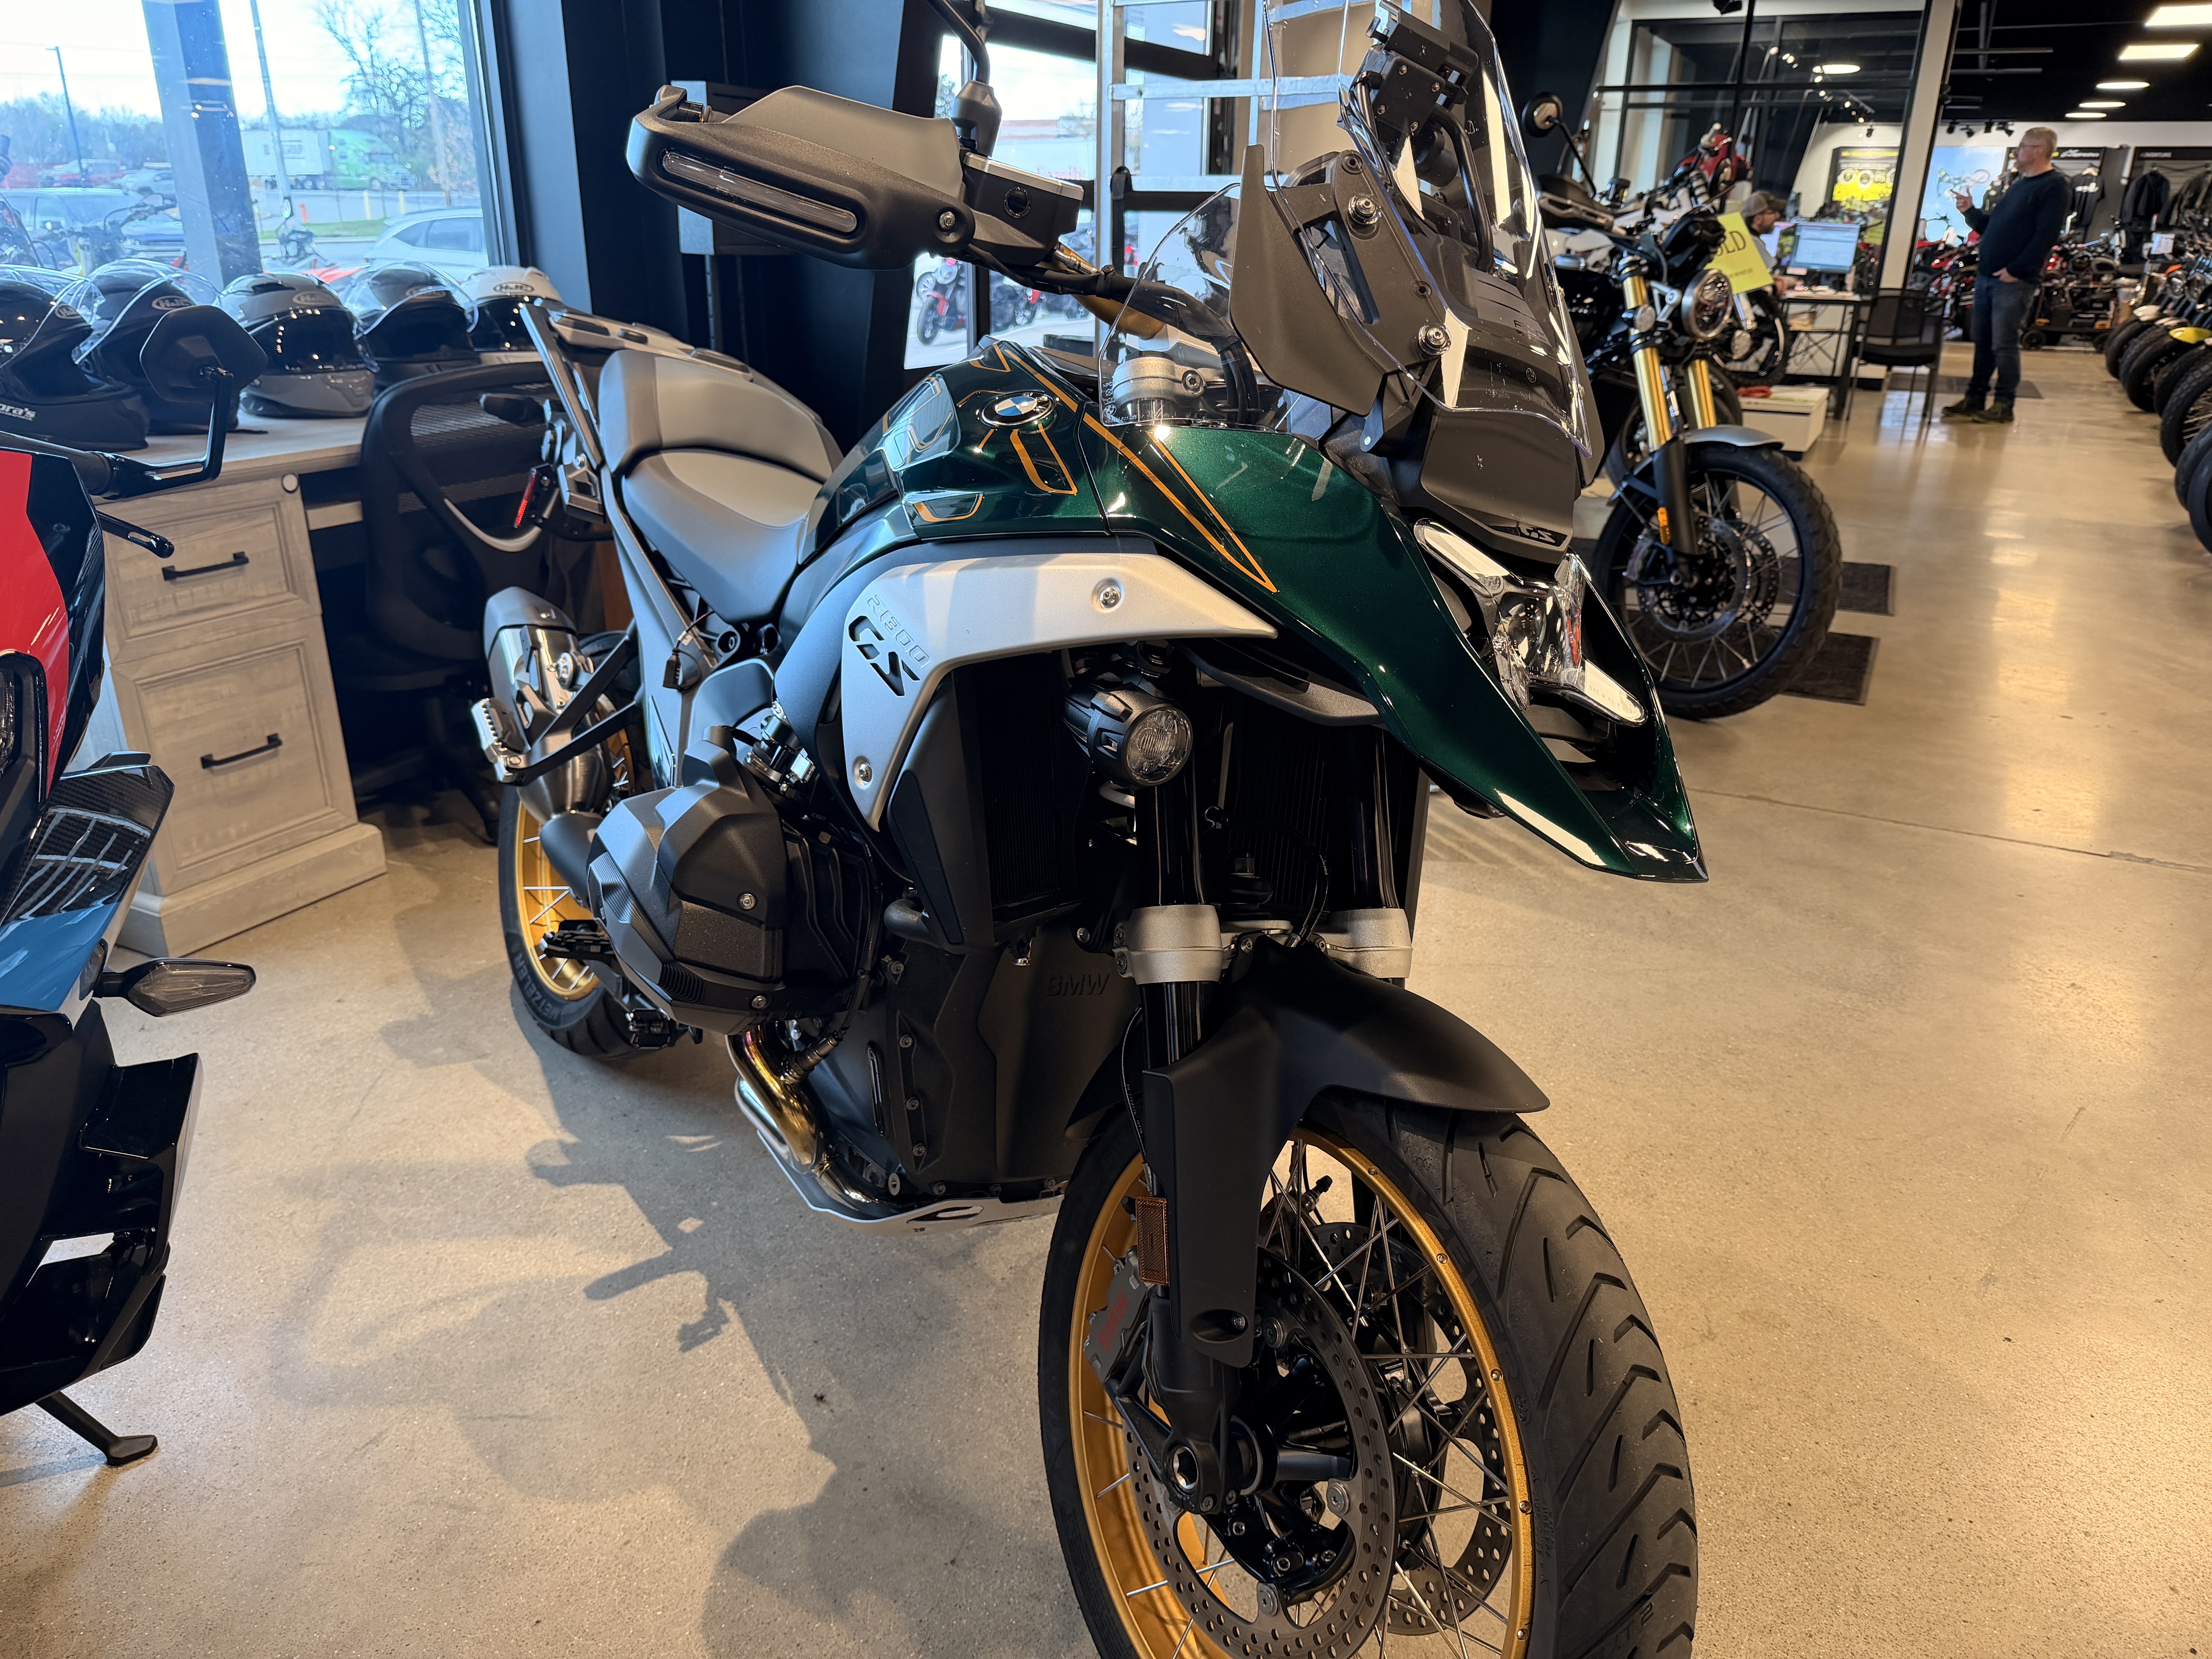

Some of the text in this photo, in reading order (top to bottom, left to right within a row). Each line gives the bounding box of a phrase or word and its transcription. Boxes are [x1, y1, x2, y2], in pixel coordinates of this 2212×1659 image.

[1519, 524, 1555, 543] GS
[848, 615, 921, 697] GS
[867, 594, 930, 668] R1300
[514, 952, 561, 1021] METZELER
[1046, 974, 1109, 997] BMW
[1098, 1289, 1129, 1352] BMW
